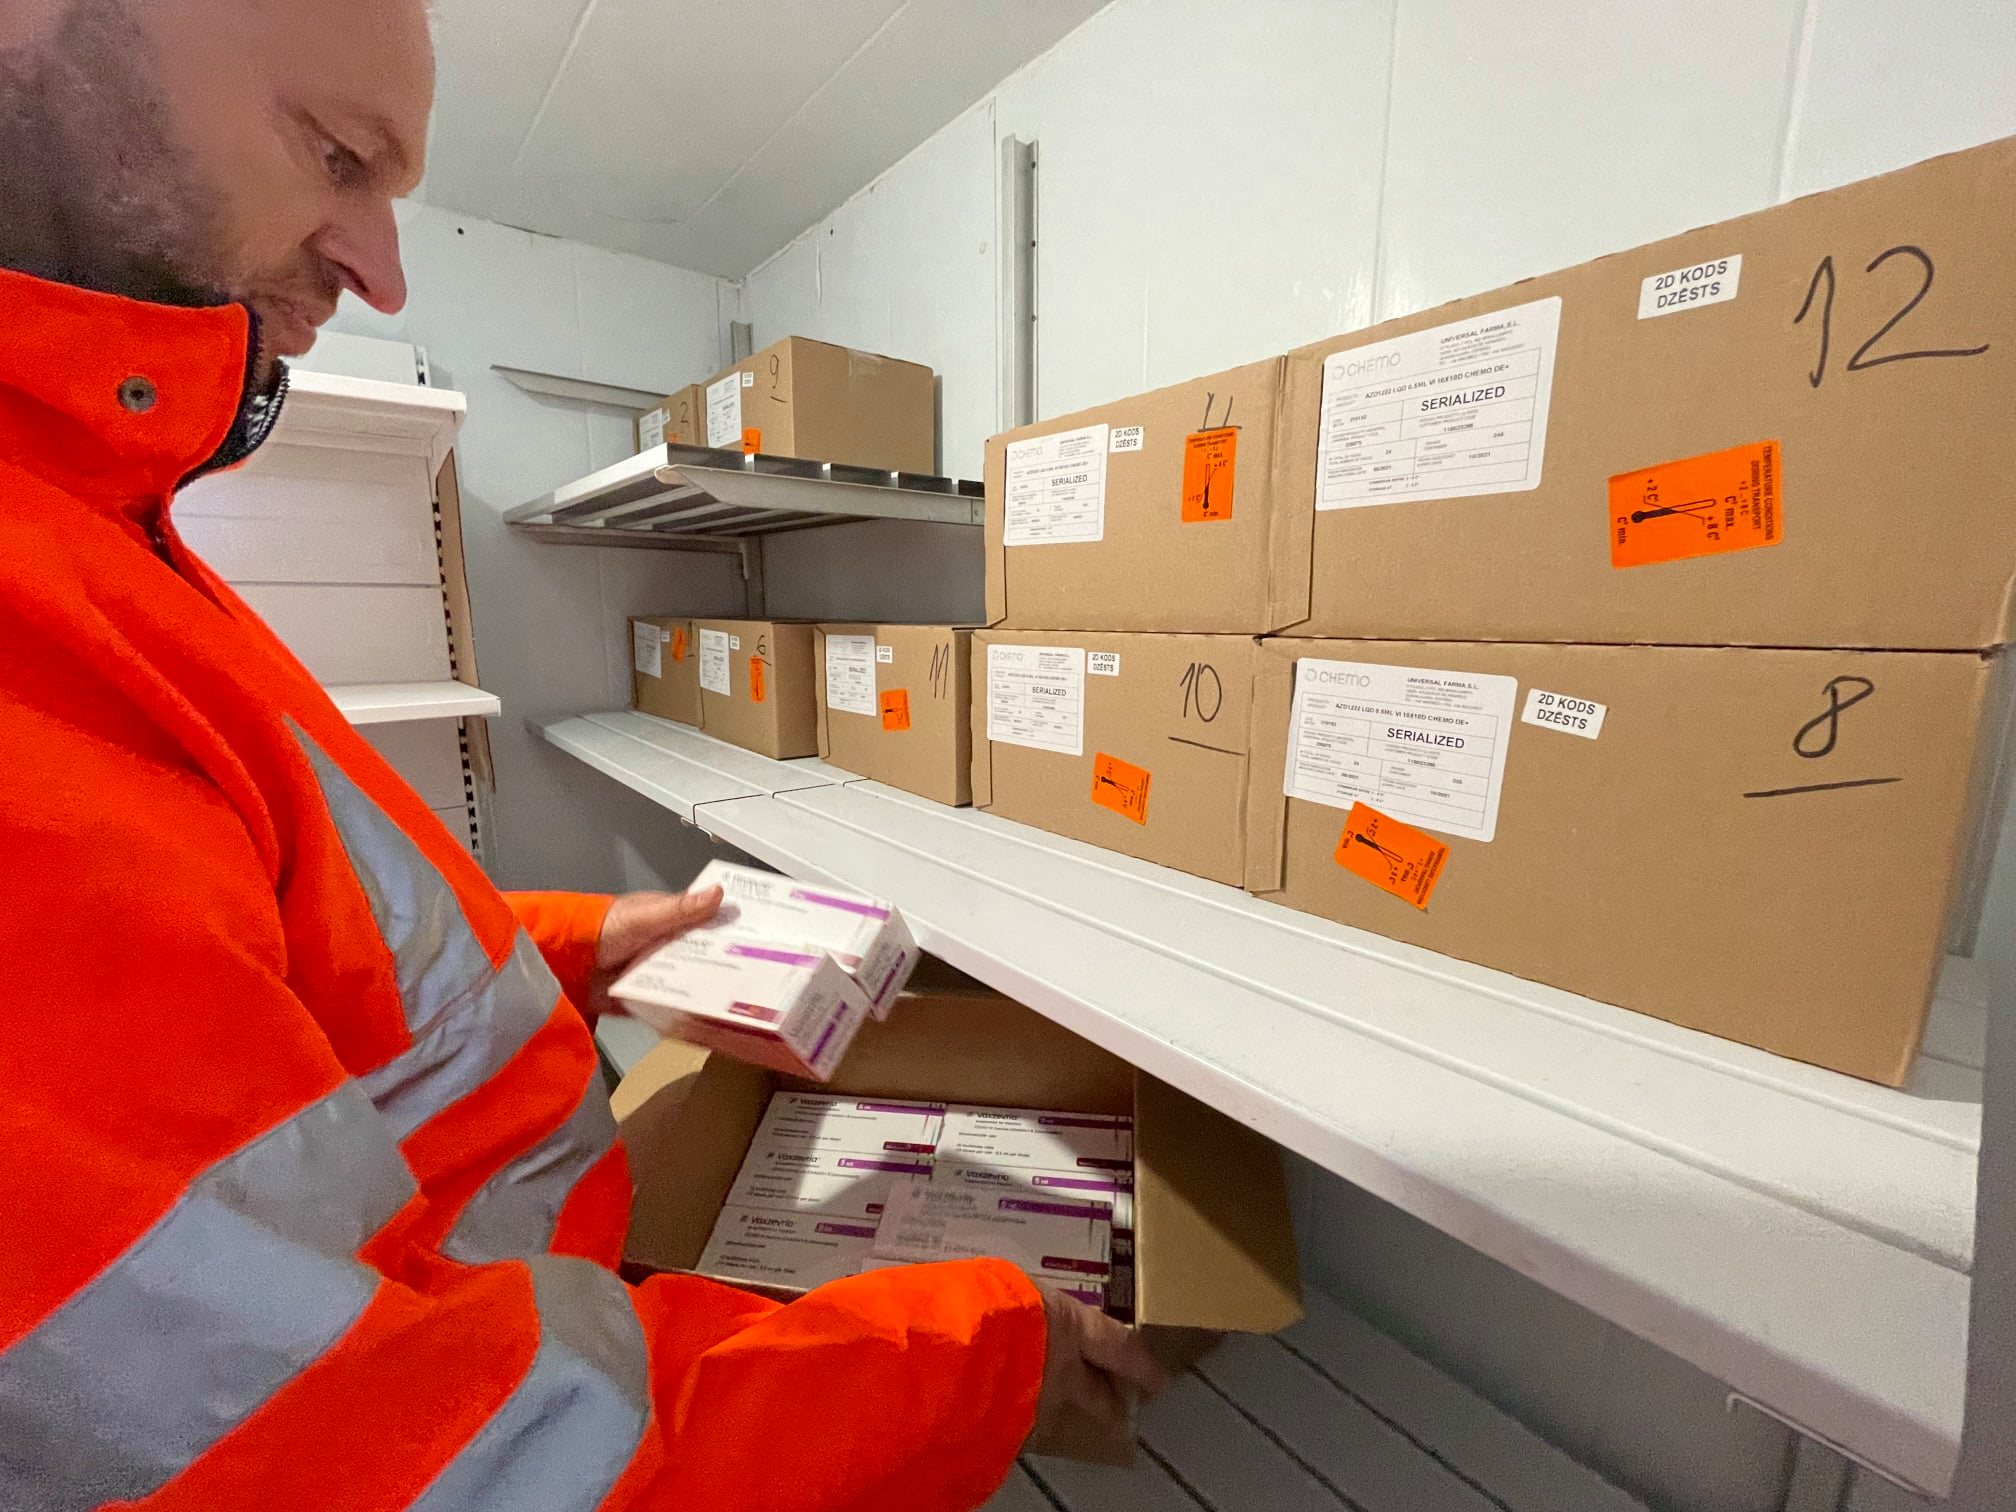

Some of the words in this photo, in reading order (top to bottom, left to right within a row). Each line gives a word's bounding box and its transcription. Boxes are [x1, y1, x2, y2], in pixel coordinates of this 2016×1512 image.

[1655, 275, 1676, 291] 2D
[1680, 260, 1728, 284] KODS
[1656, 281, 1721, 309] DZĒSTS
[1793, 244, 1991, 388] 12
[1440, 330, 1478, 344] UNIVERSAL
[769, 354, 780, 390] 9
[1346, 352, 1401, 377] CHEMO
[1464, 367, 1493, 378] CHEMO
[1421, 385, 1506, 411] SERIALIZED
[1114, 430, 1122, 438] 2D
[1123, 428, 1140, 437] KODS
[1051, 474, 1088, 487] SERIALIZED
[1763, 445, 1773, 496] TEMPERATURE
[1752, 488, 1761, 530] TRANSPORT
[1764, 497, 1774, 541] CONDITIONS
[757, 634, 767, 656] 6
[1319, 671, 1371, 688] CHEMO
[1407, 677, 1442, 686] UNIVERSAL
[1031, 686, 1067, 697] SERIALIZED
[1180, 663, 1223, 723] 10
[1538, 693, 1555, 706] 2D
[1558, 697, 1596, 716] KODS
[1428, 715, 1454, 724] CHEMO
[1536, 708, 1588, 731] DZĒSTS
[1792, 675, 1875, 759] 8
[1387, 727, 1465, 749] SERIALIZED
[777, 1153, 818, 1163] Vaxzevria
[751, 1216, 795, 1228] Vaxzevria
